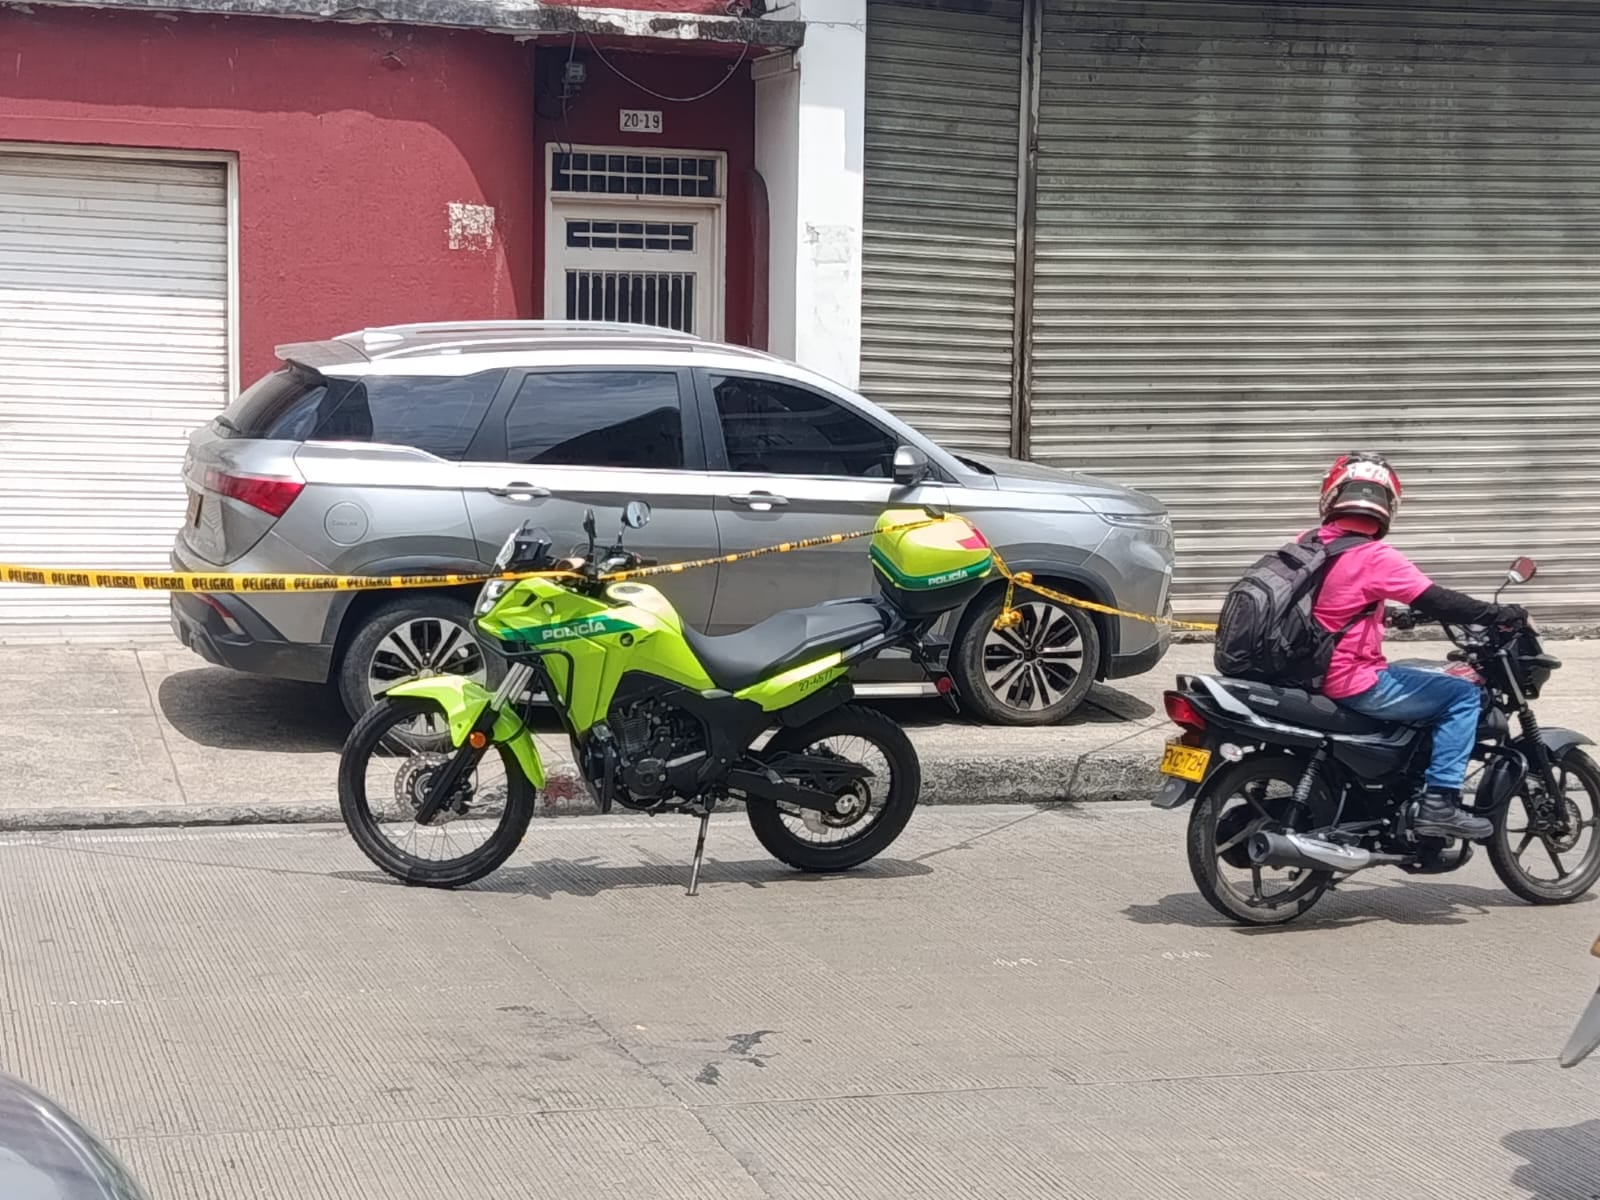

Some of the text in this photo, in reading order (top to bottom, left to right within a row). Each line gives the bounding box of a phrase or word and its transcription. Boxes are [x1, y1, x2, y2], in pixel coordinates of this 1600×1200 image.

[624, 113, 660, 129] 20-19
[8, 568, 45, 585] PELIGRO
[51, 572, 90, 587] PELIGRO
[96, 575, 137, 589] PELIGRO
[143, 577, 185, 590] PELIGRO
[192, 577, 234, 590] PELIGRO
[242, 577, 286, 590] PELIGRO
[294, 577, 338, 590] PELIGRO
[541, 618, 607, 640] POLICÍA
